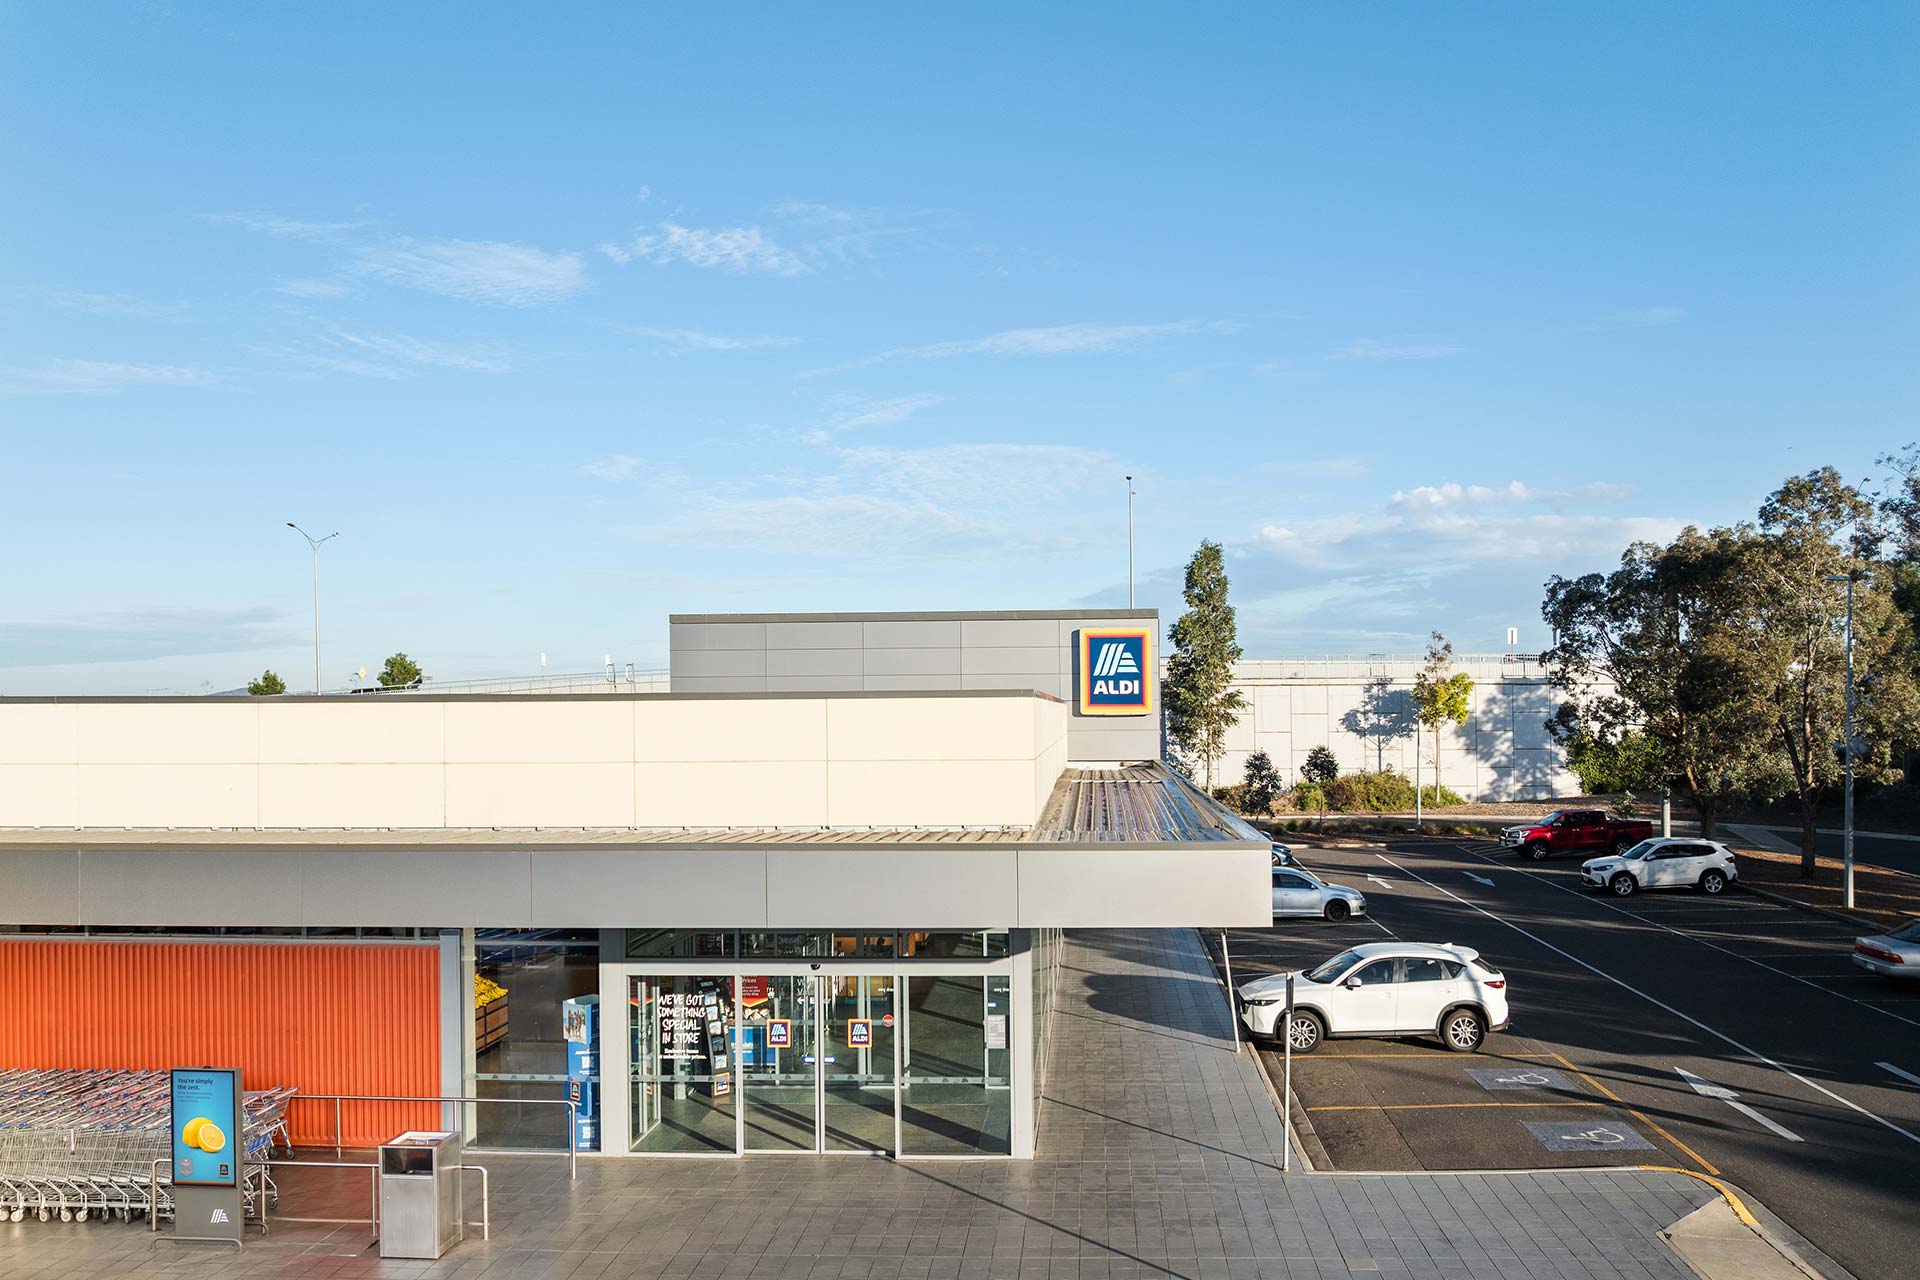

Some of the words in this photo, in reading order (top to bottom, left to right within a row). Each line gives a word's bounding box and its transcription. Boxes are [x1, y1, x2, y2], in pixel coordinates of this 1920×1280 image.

[1093, 680, 1139, 695] ALDI
[658, 994, 684, 1006] WE'VE
[685, 994, 704, 1006] GOT
[657, 1007, 706, 1018] SOMETHING
[662, 1019, 702, 1031] SPECIAL
[662, 1032, 671, 1044] IN
[673, 1032, 700, 1044] STORE
